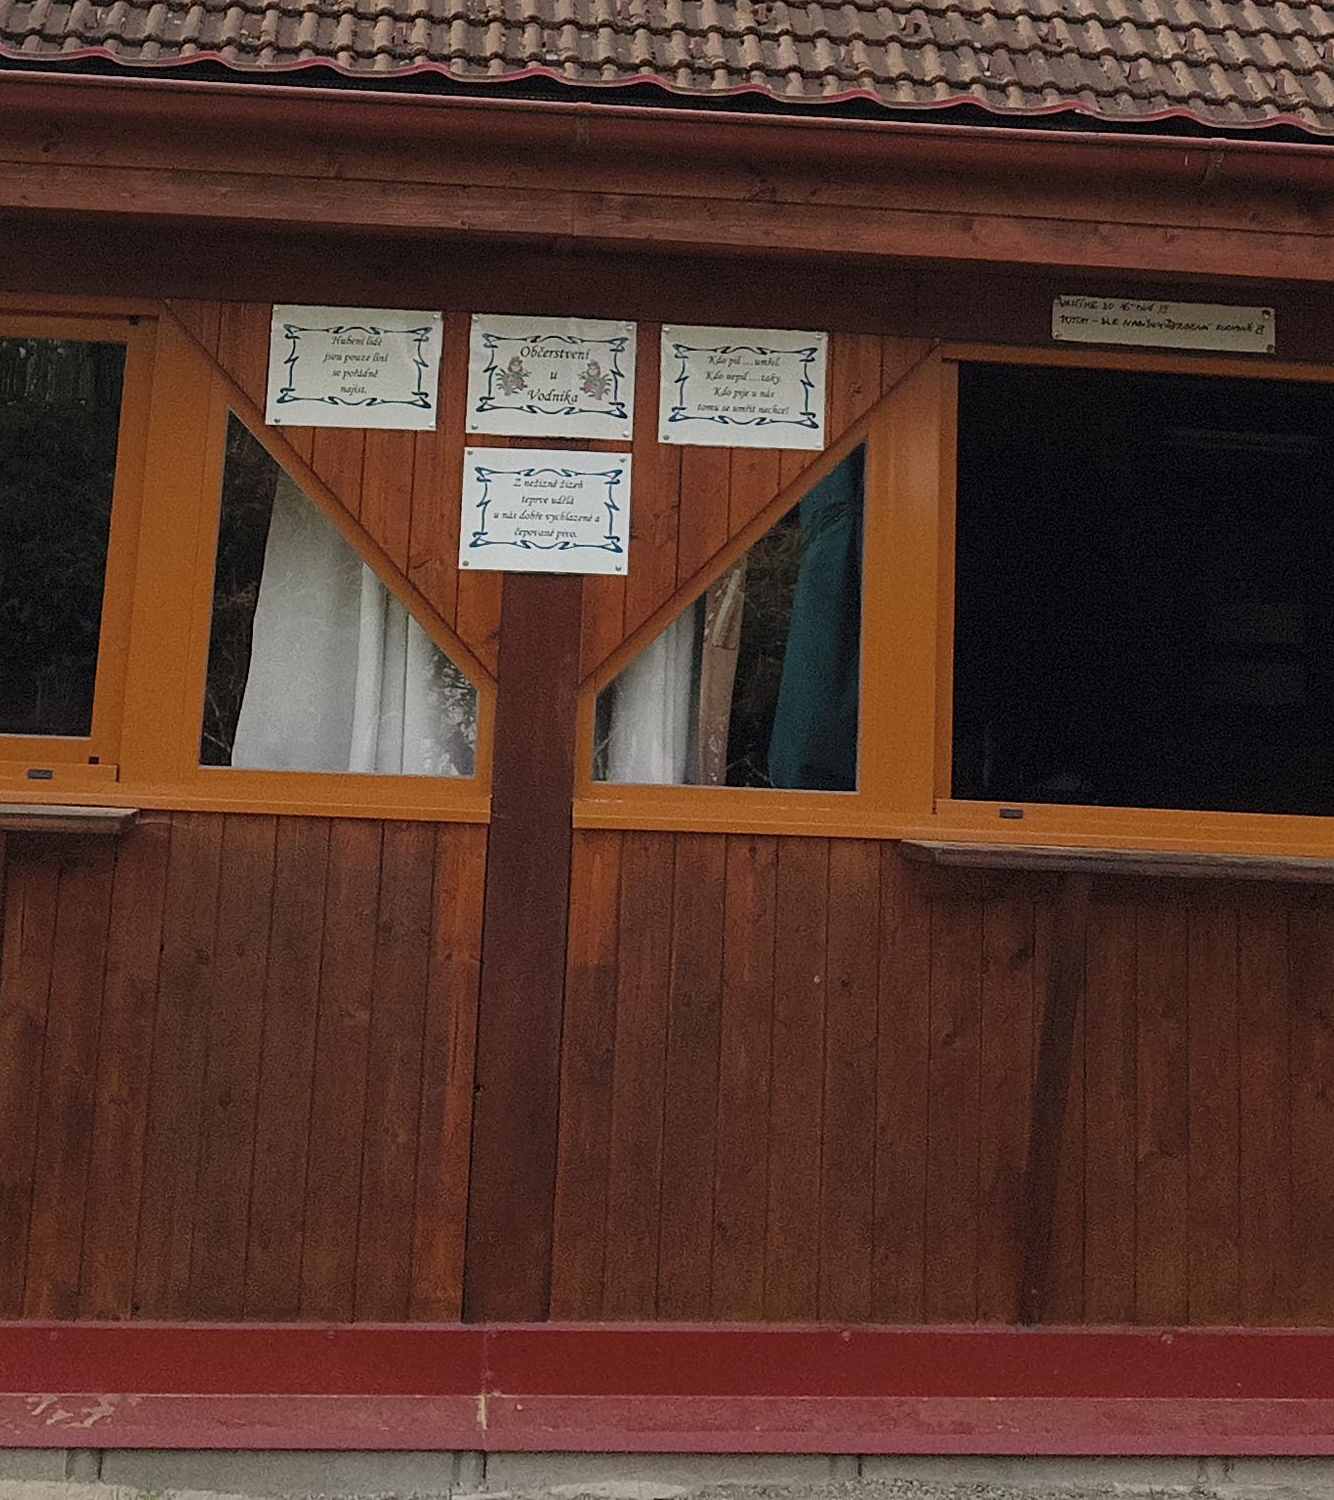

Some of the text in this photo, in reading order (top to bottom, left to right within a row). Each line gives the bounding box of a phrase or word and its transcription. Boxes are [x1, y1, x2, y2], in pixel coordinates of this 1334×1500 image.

[323, 352, 342, 363] jsou
[343, 354, 371, 363] pouze
[520, 345, 592, 360] Občerstvení
[550, 372, 558, 380] u
[527, 388, 578, 405] Vodníka
[713, 387, 732, 397] Kdo
[697, 403, 719, 412] tomu
